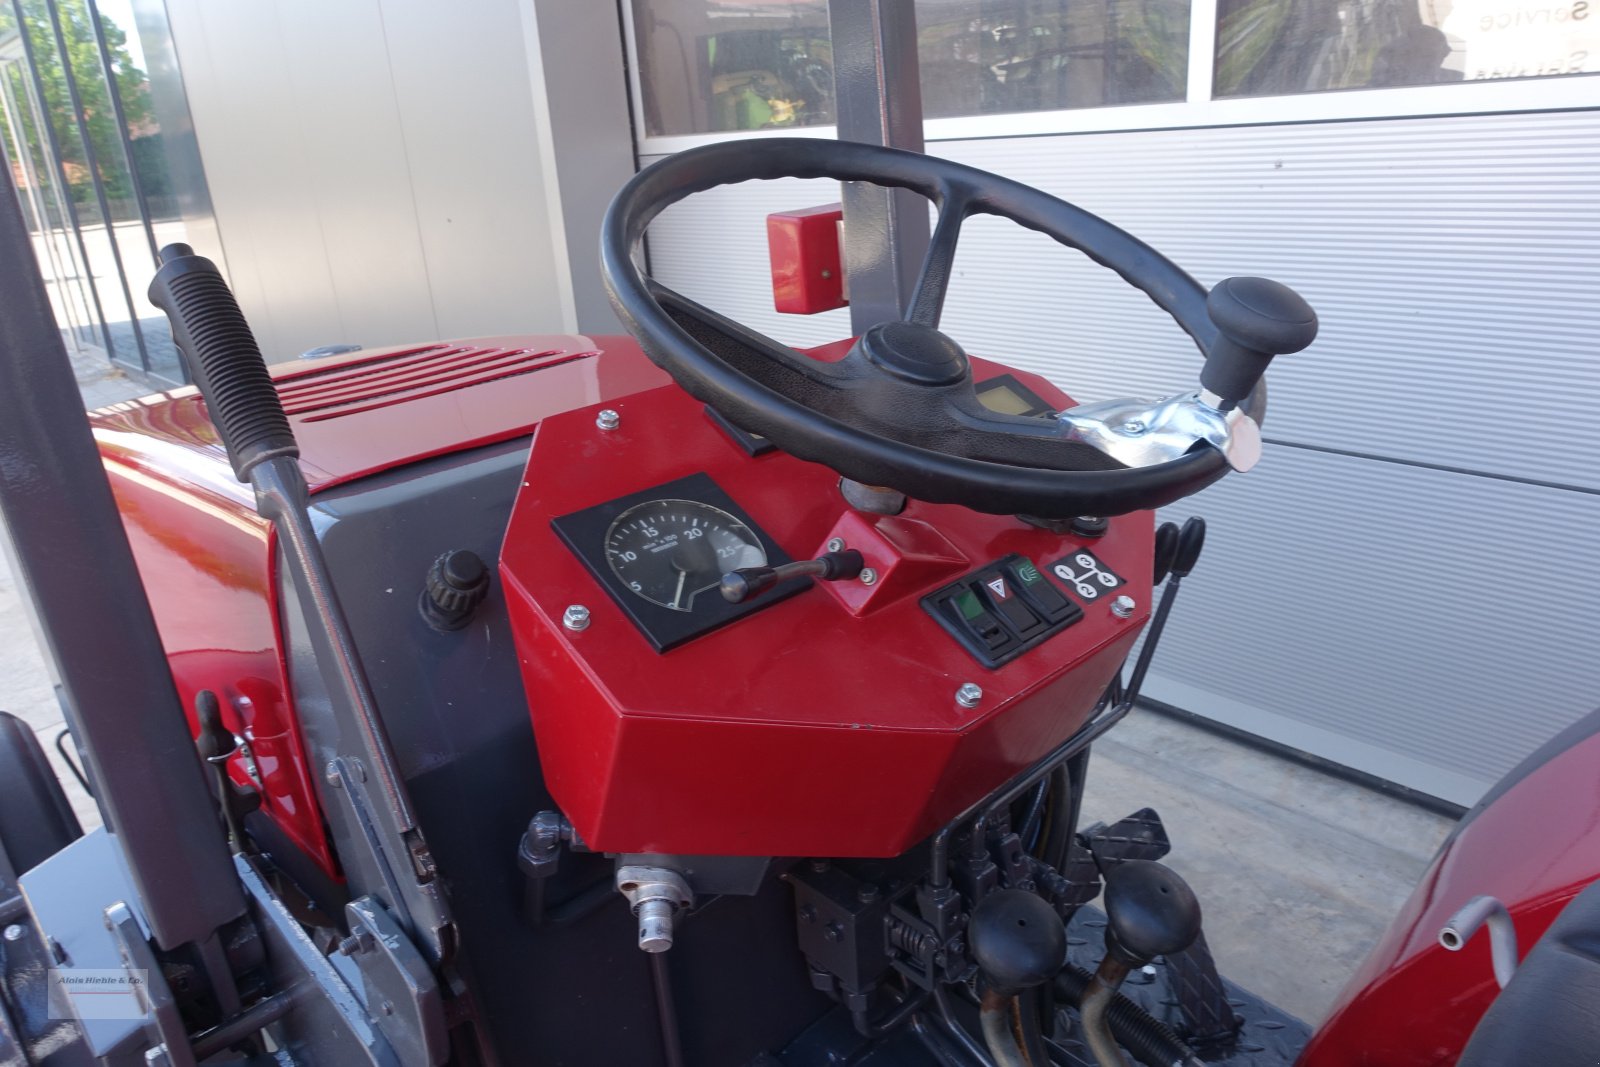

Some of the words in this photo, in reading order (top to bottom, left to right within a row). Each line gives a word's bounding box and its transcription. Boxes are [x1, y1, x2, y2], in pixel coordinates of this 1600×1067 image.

[642, 526, 659, 538] 15
[684, 527, 704, 540] 20
[619, 550, 637, 563] 10
[717, 545, 736, 559] 25
[630, 580, 642, 592] 5
